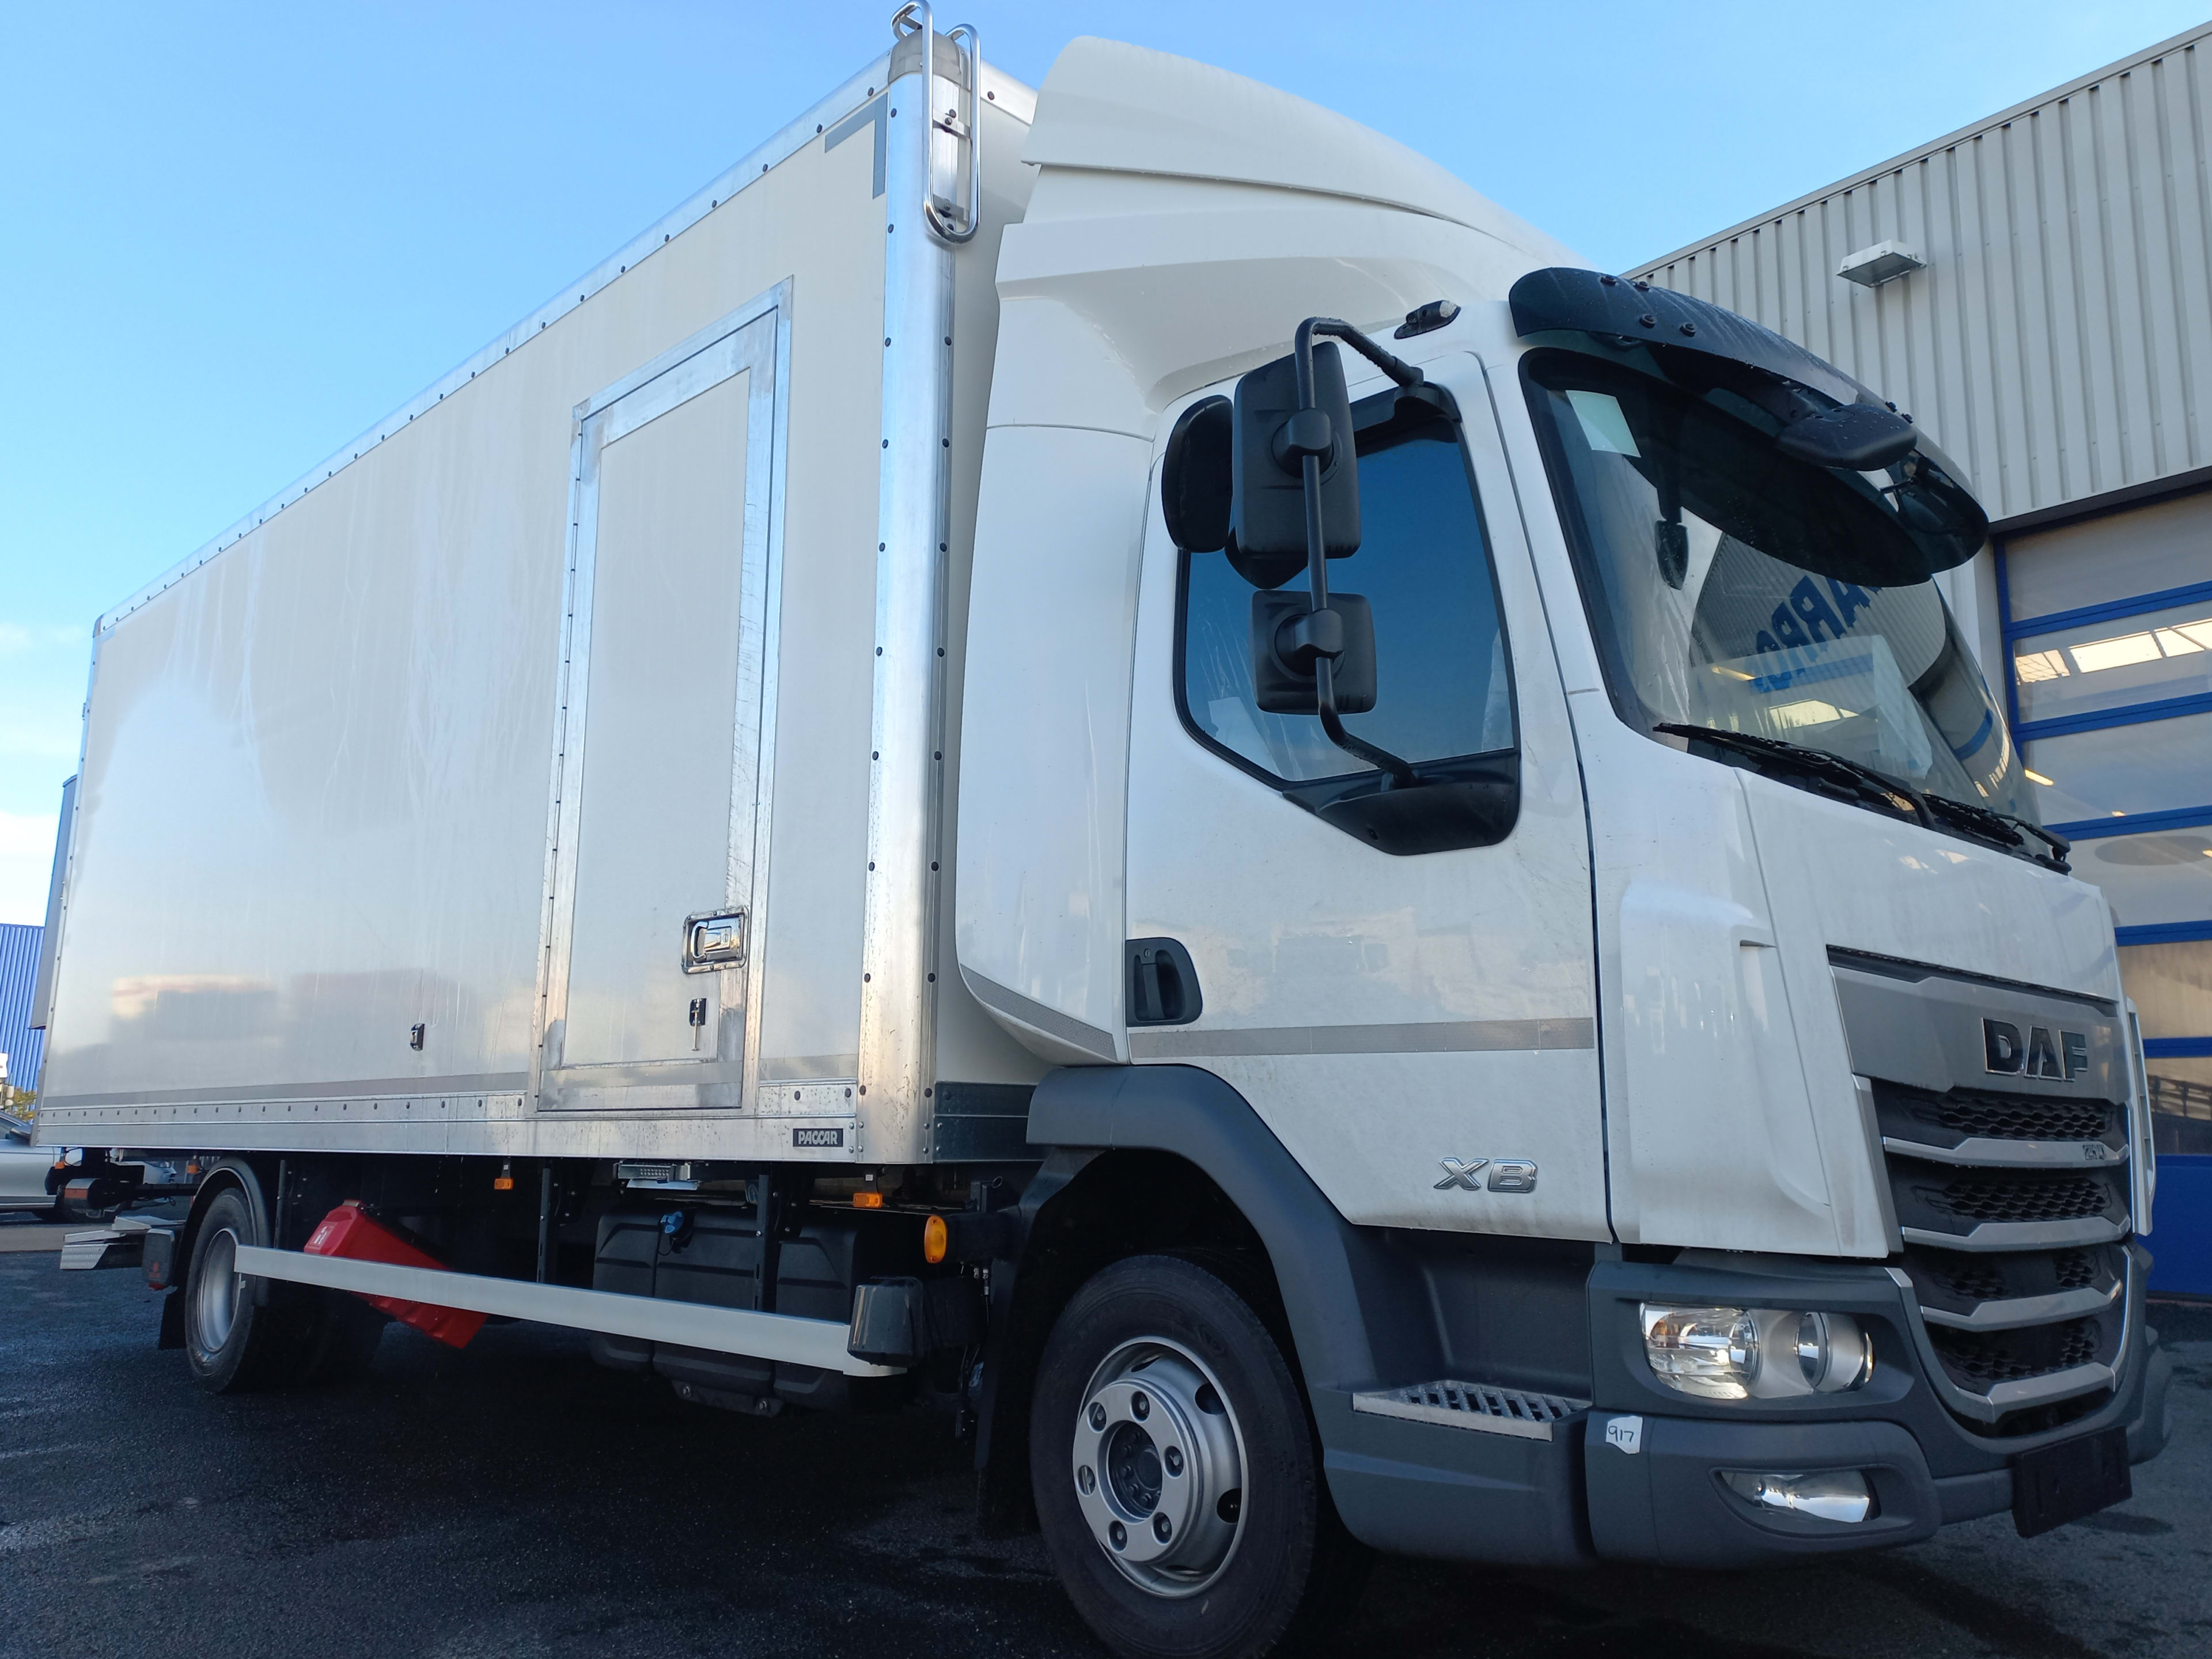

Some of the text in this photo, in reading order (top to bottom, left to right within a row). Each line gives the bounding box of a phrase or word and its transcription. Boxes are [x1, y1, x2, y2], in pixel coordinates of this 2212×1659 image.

[1982, 1017, 2088, 1082] DAF
[798, 1130, 838, 1145] PACCAR
[1433, 1157, 1538, 1194] XB
[1608, 1425, 1634, 1443] 917
